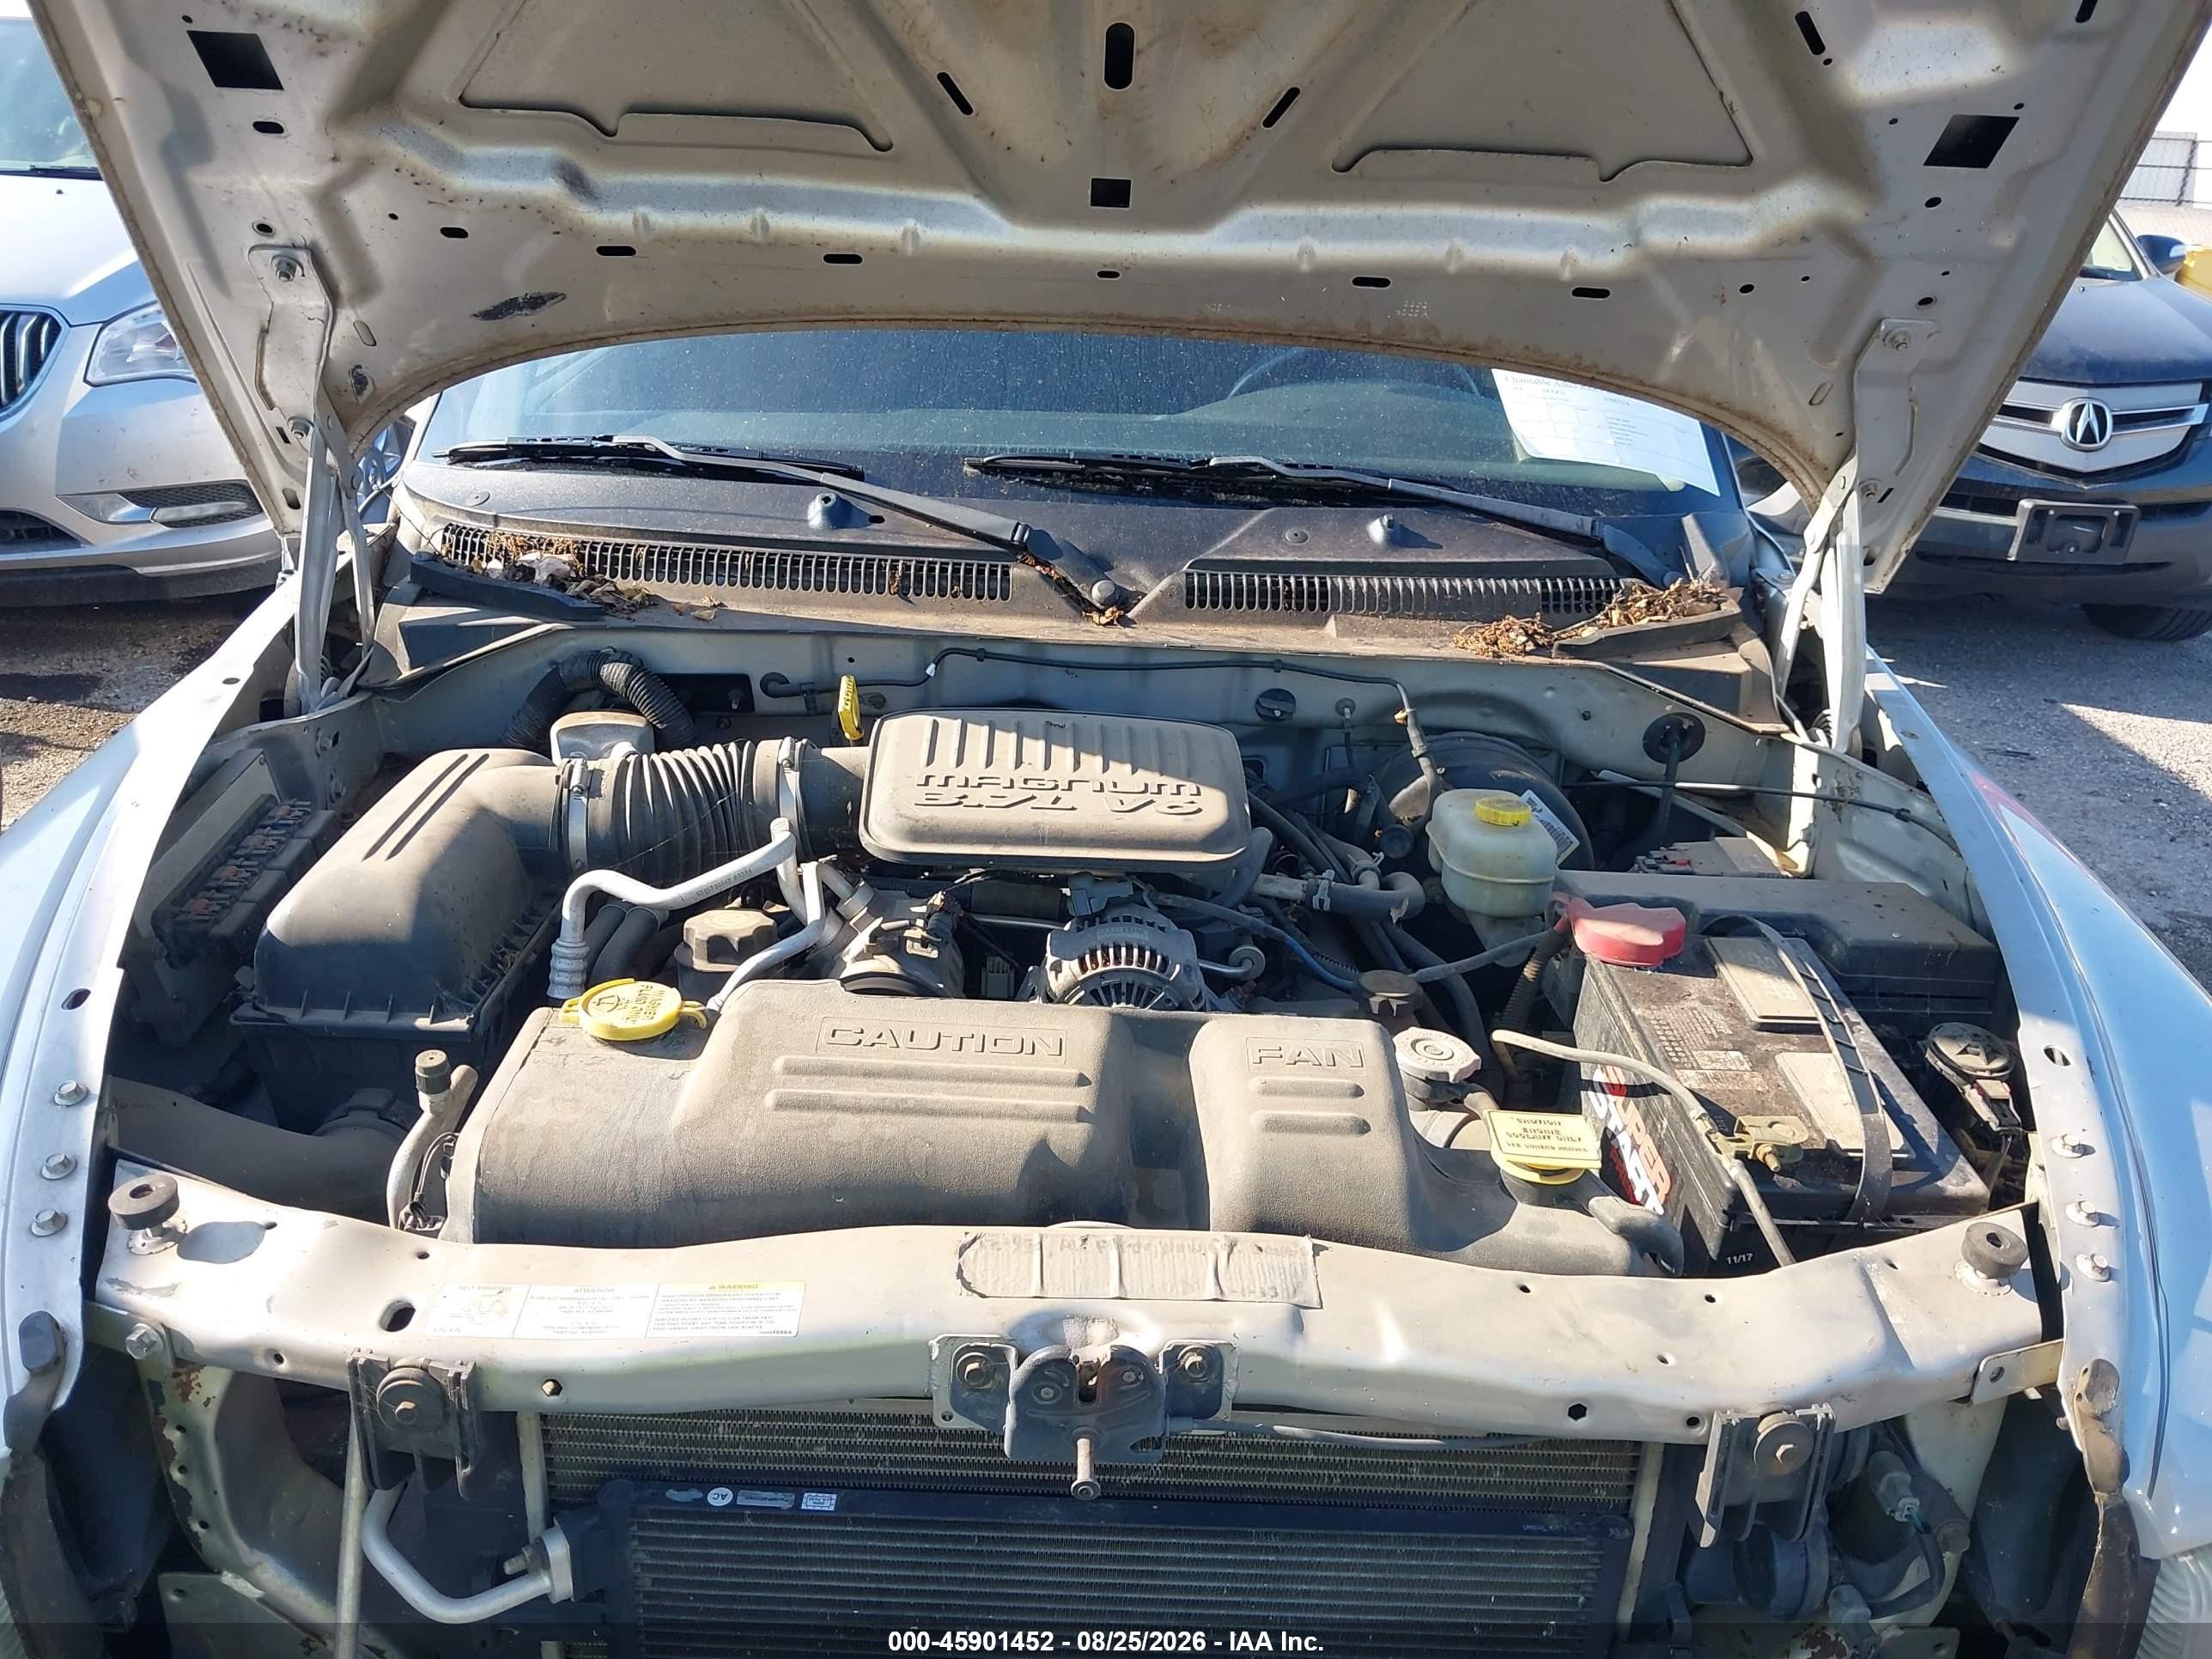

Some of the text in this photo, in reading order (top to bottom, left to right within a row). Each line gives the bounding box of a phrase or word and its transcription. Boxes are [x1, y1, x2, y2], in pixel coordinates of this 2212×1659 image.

[916, 774, 1203, 797] MAGNUM
[1105, 798, 1203, 816] V6
[823, 1027, 1064, 1057] CAUTION
[1249, 1044, 1365, 1069] FAN
[1726, 1253, 1753, 1264] 11/17
